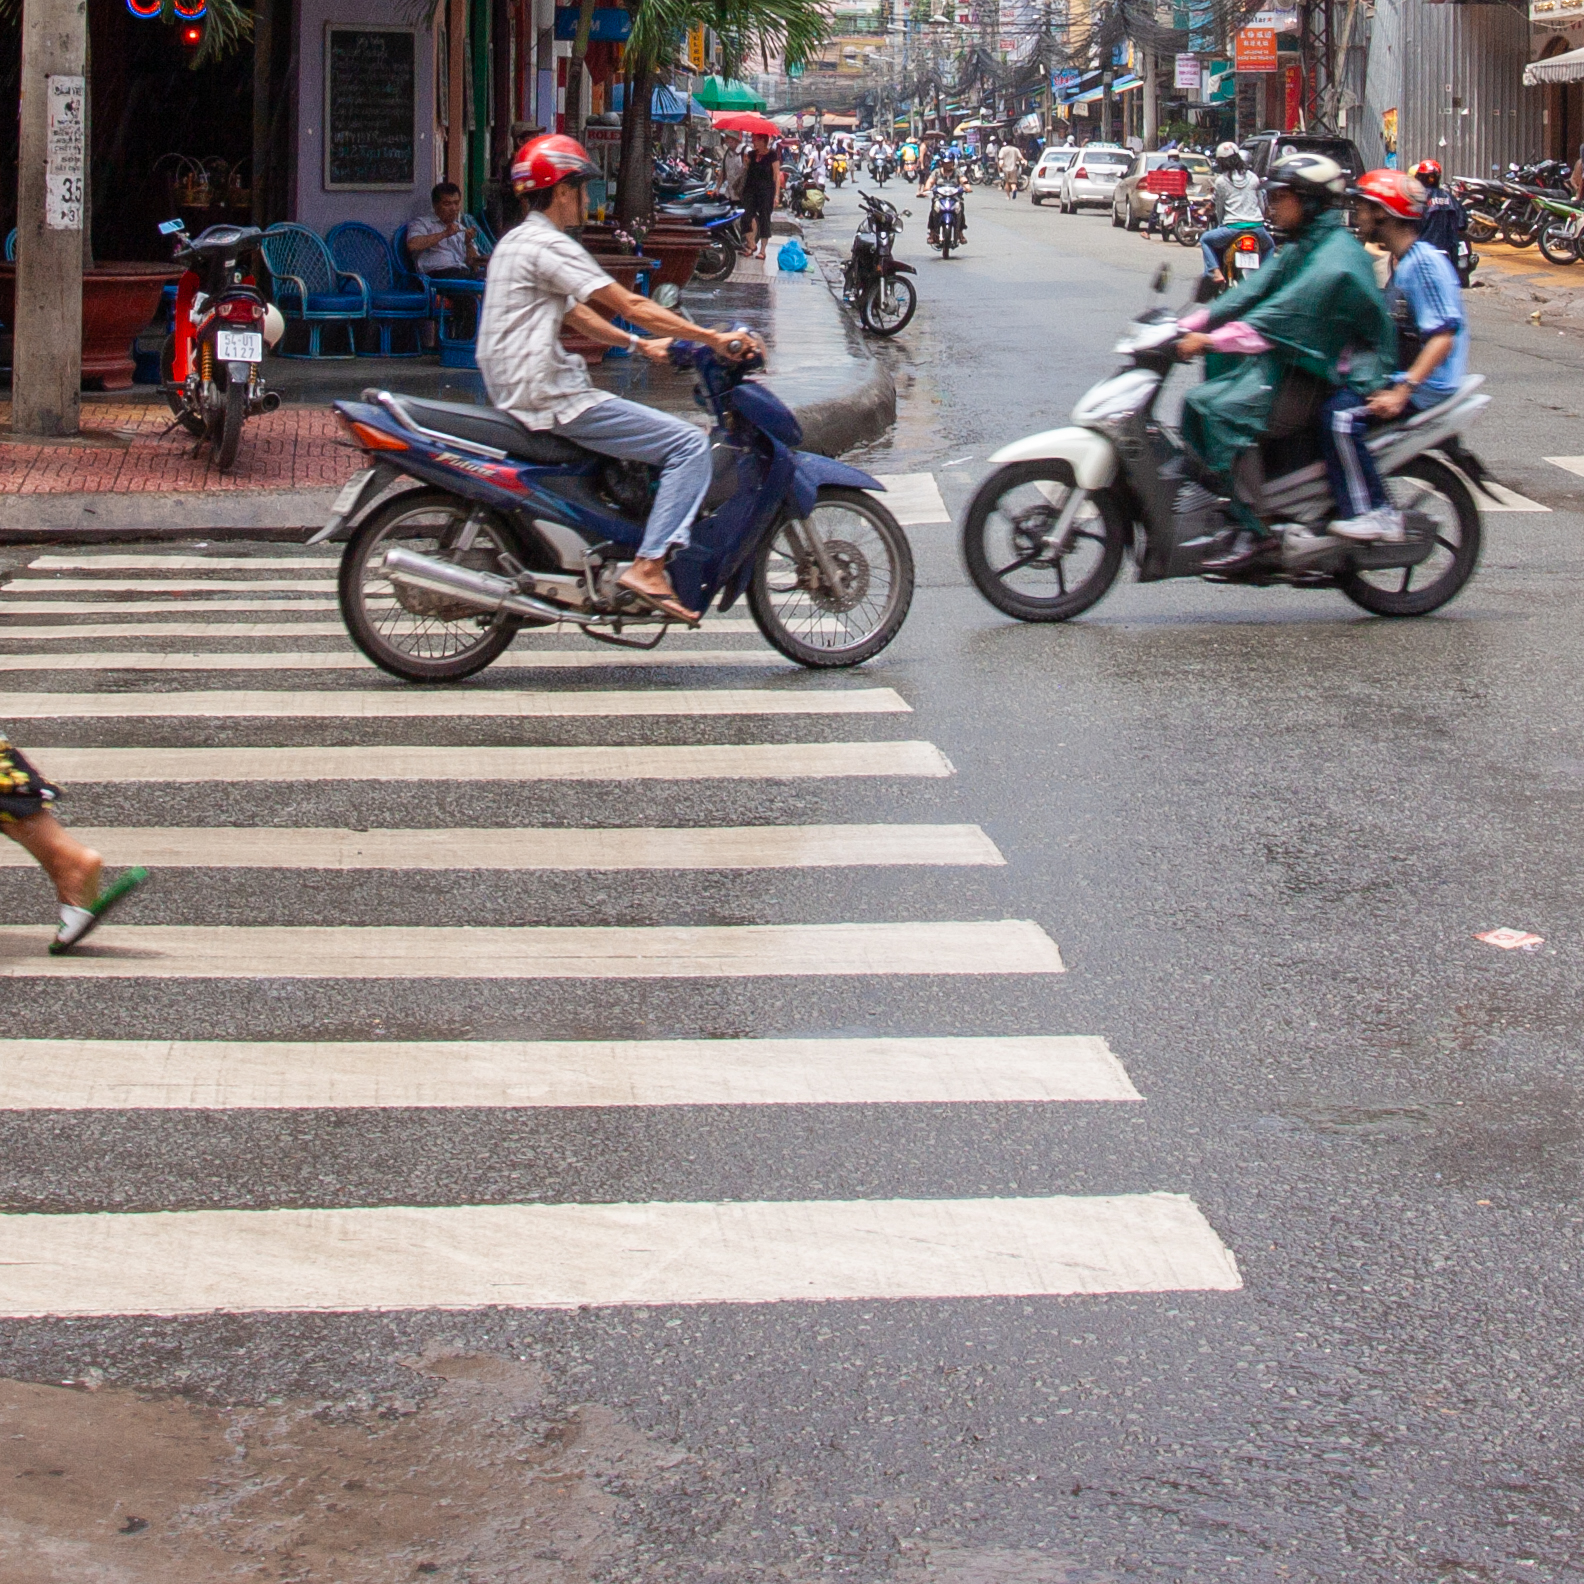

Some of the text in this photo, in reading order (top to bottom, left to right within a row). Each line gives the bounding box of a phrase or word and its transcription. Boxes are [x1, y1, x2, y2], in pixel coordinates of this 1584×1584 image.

[568, 21, 601, 32] AM
[224, 335, 254, 347] 54-U1
[224, 346, 255, 359] 4127
